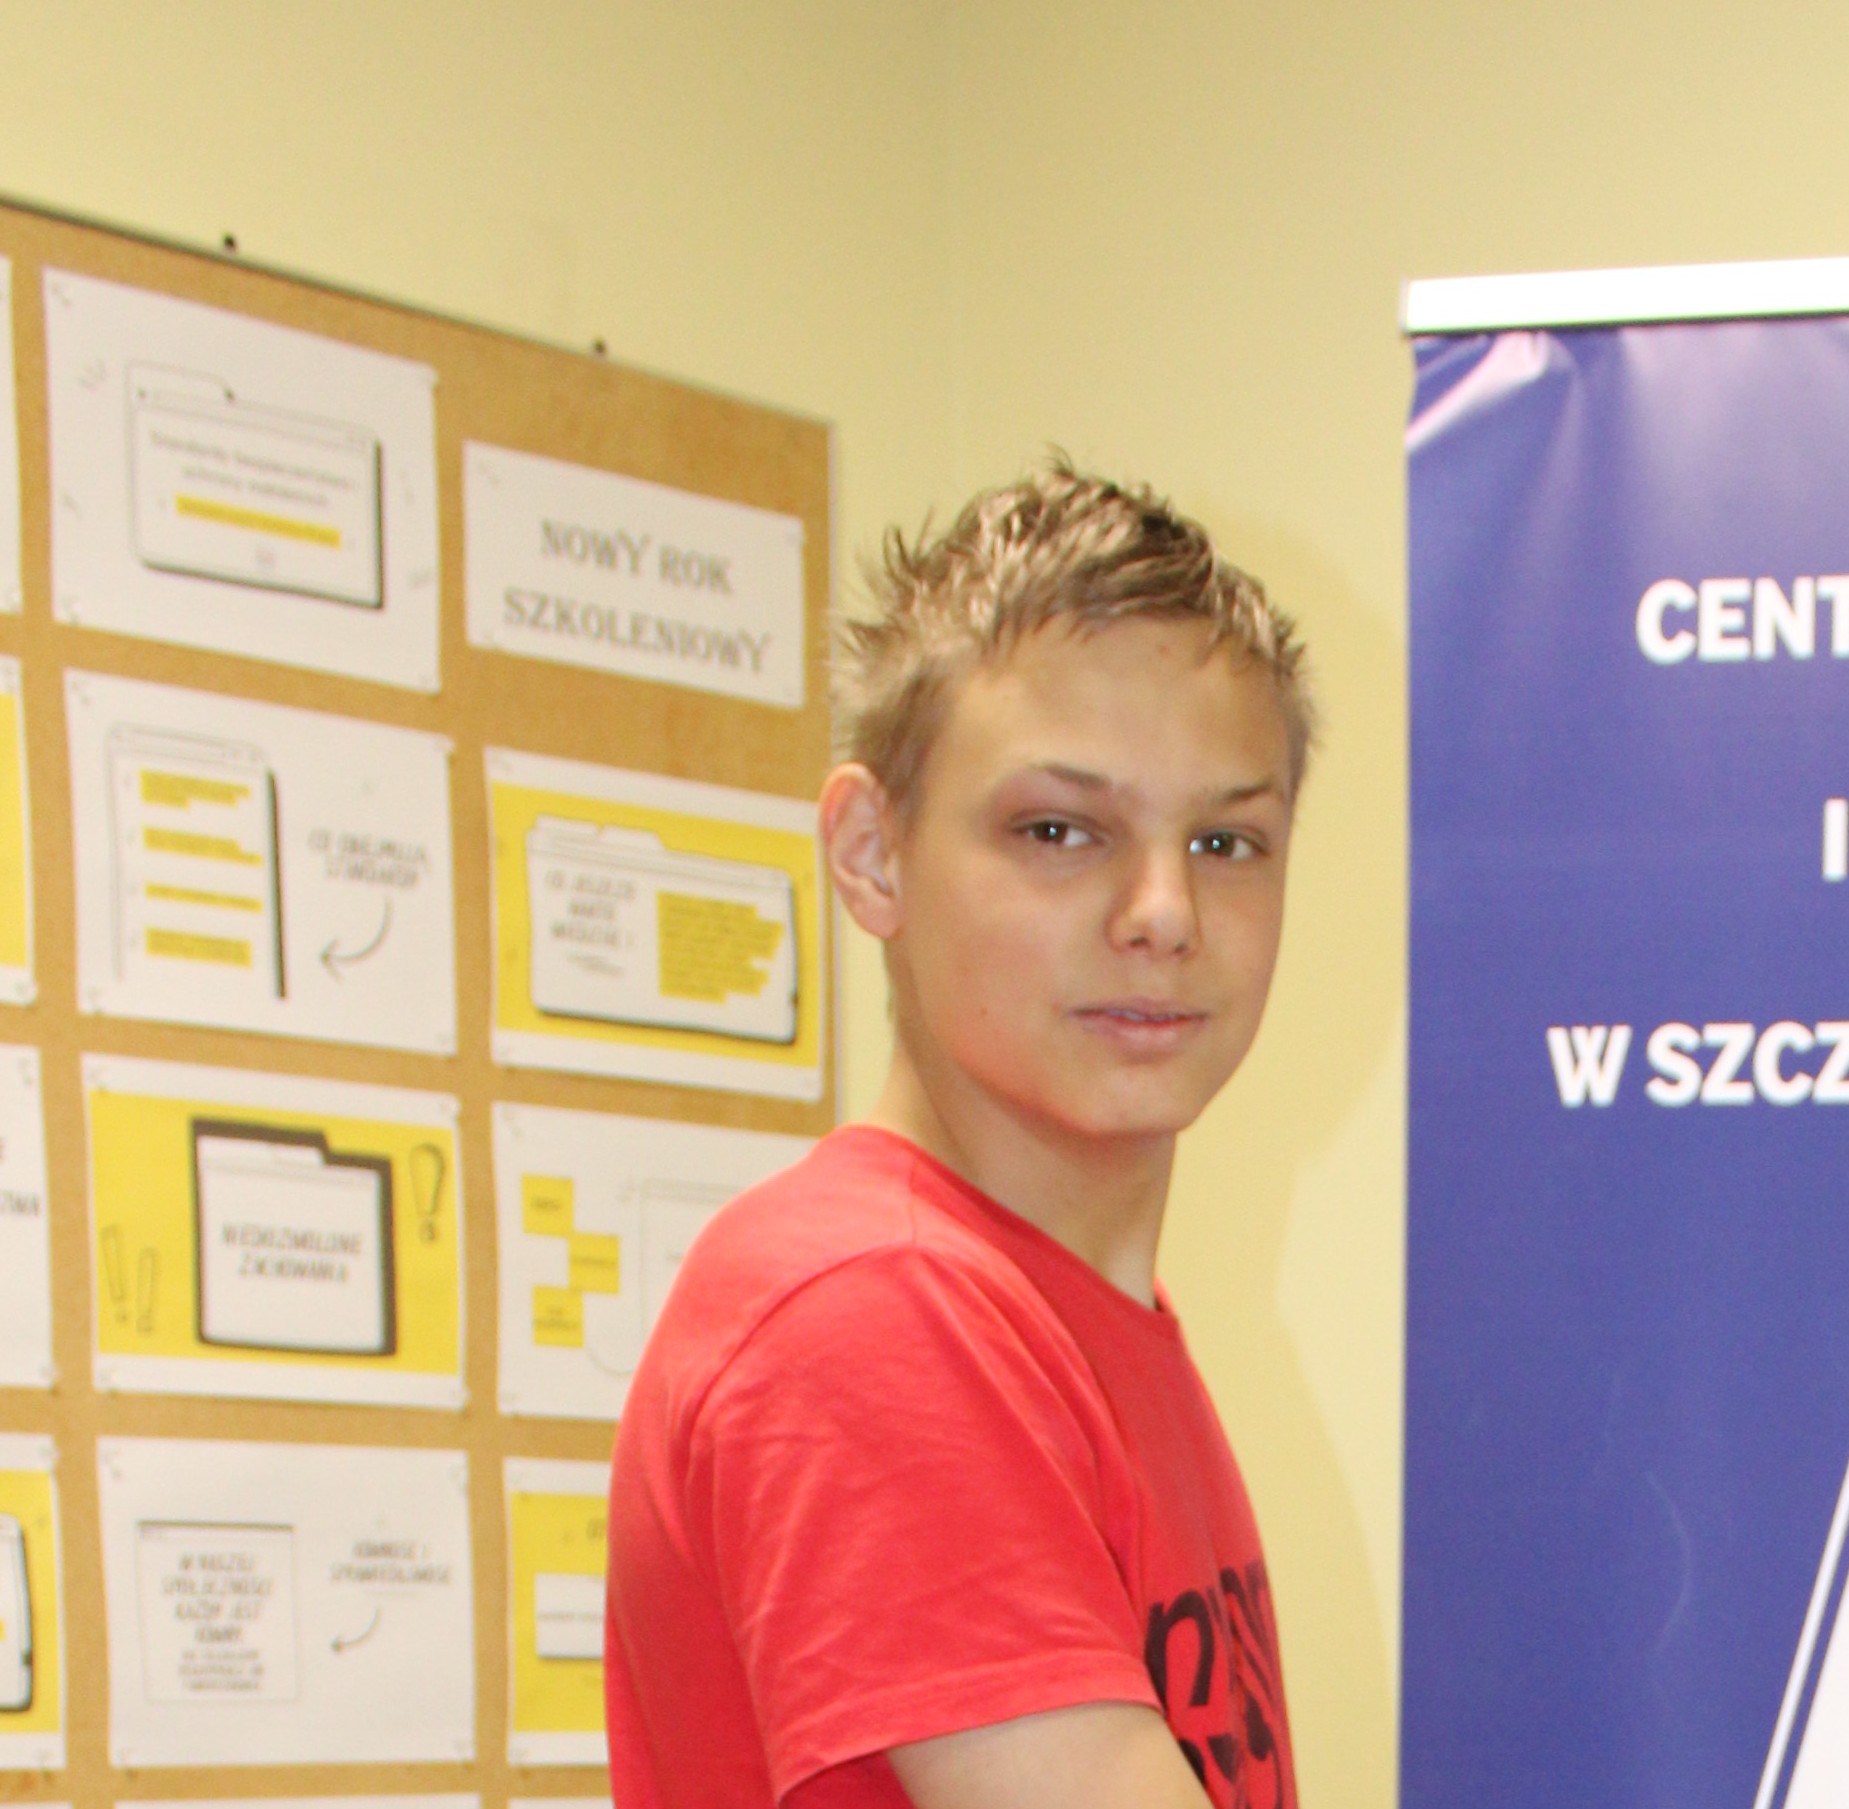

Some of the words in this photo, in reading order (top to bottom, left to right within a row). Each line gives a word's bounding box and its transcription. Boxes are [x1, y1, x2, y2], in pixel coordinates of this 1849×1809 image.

[540, 518, 650, 578] NOWY
[658, 545, 734, 595] ROK
[503, 586, 770, 673] SZKOLENIOWY
[1823, 799, 1849, 881] I
[1548, 1026, 1632, 1106] W
